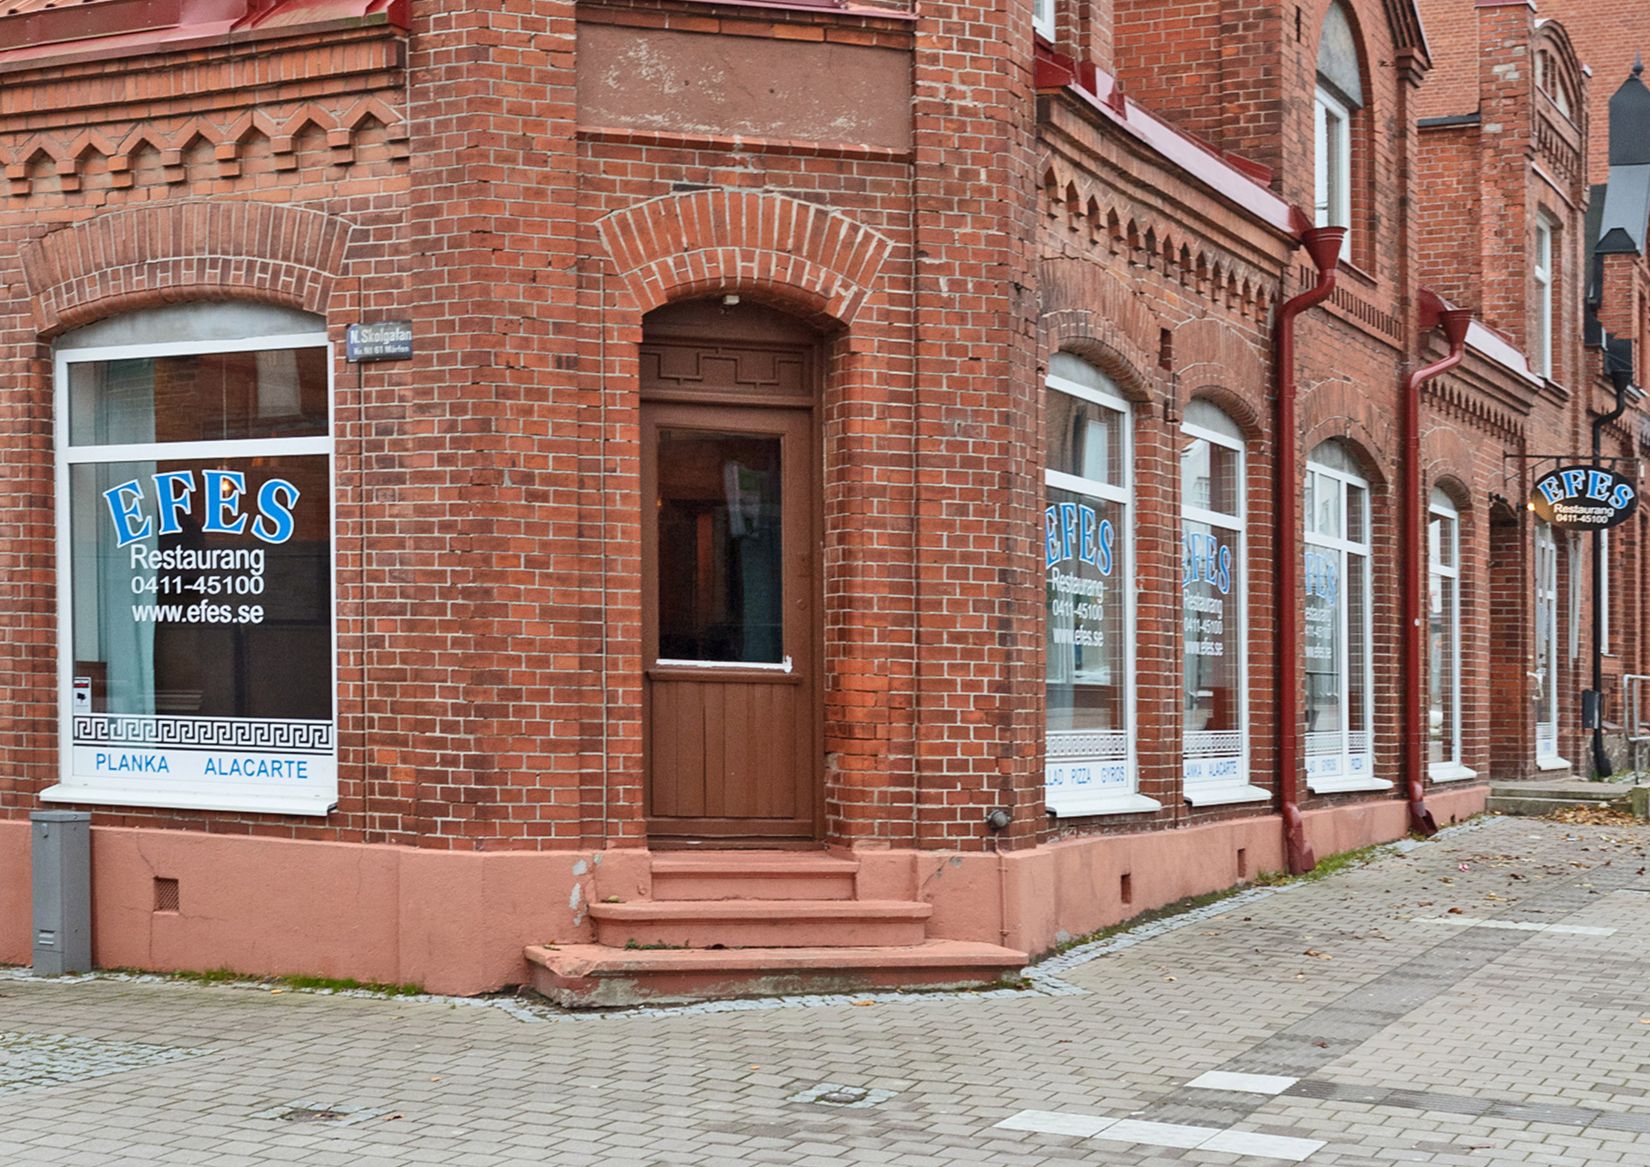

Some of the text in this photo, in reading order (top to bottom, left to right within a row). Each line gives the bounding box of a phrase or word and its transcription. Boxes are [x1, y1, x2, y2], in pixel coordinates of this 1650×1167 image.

[1537, 469, 1635, 509] EFES
[103, 470, 301, 548] EFES
[1553, 503, 1615, 517] Restaurang
[1555, 514, 1608, 524] 0411-45100
[1045, 502, 1115, 576] EFES
[131, 544, 265, 576] Restaurang
[131, 575, 265, 595] 0411-45100
[1052, 567, 1104, 603] Restaurang
[132, 599, 264, 623] www.efes.se
[1052, 599, 1104, 621] 0411-45100
[1053, 625, 1104, 647] www.efes.se
[96, 753, 308, 779] PLANKA ALACARTE
[1071, 767, 1092, 784] PIZZA
